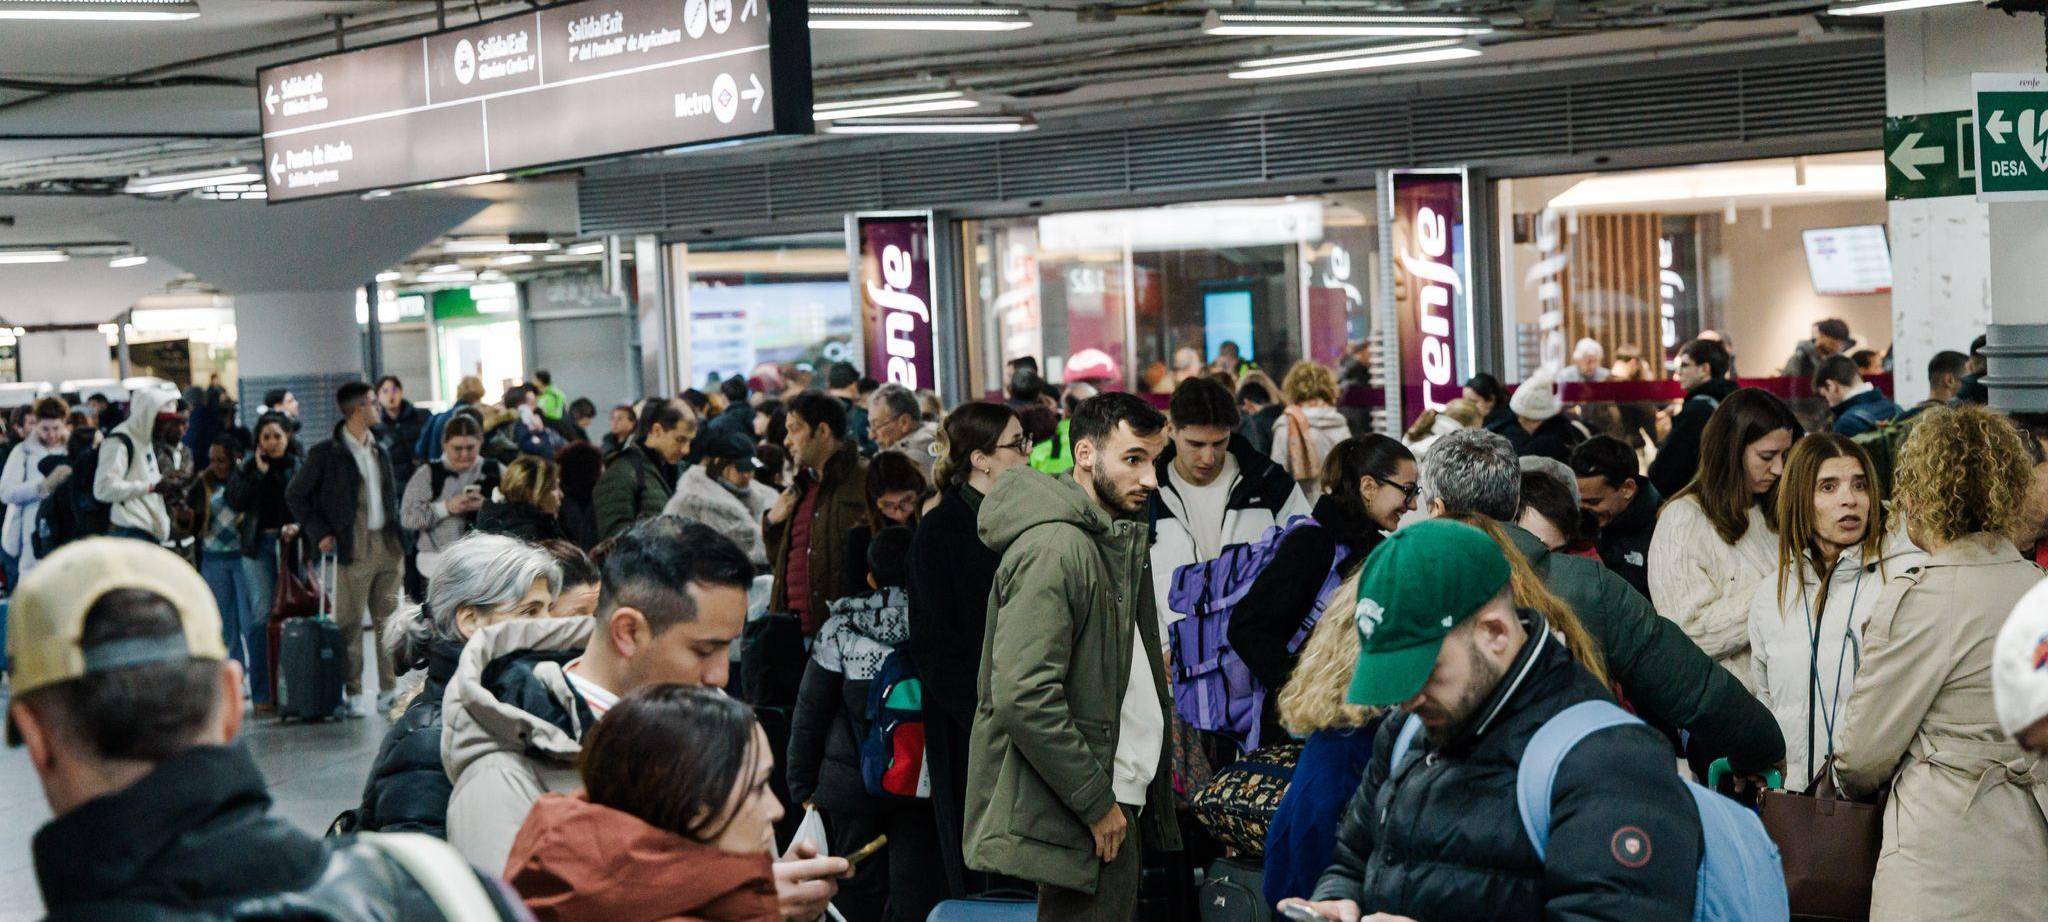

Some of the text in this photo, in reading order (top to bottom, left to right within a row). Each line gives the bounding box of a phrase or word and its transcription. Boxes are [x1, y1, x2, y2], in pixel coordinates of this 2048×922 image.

[568, 10, 623, 42] Salida/Exit
[477, 30, 528, 61] Salida/Exit
[528, 54, 535, 71] V
[2019, 78, 2040, 89] renfe
[675, 92, 711, 117] Metro
[1991, 160, 2028, 177] DESA
[867, 244, 930, 391] enfe
[1401, 206, 1463, 413] renfe
